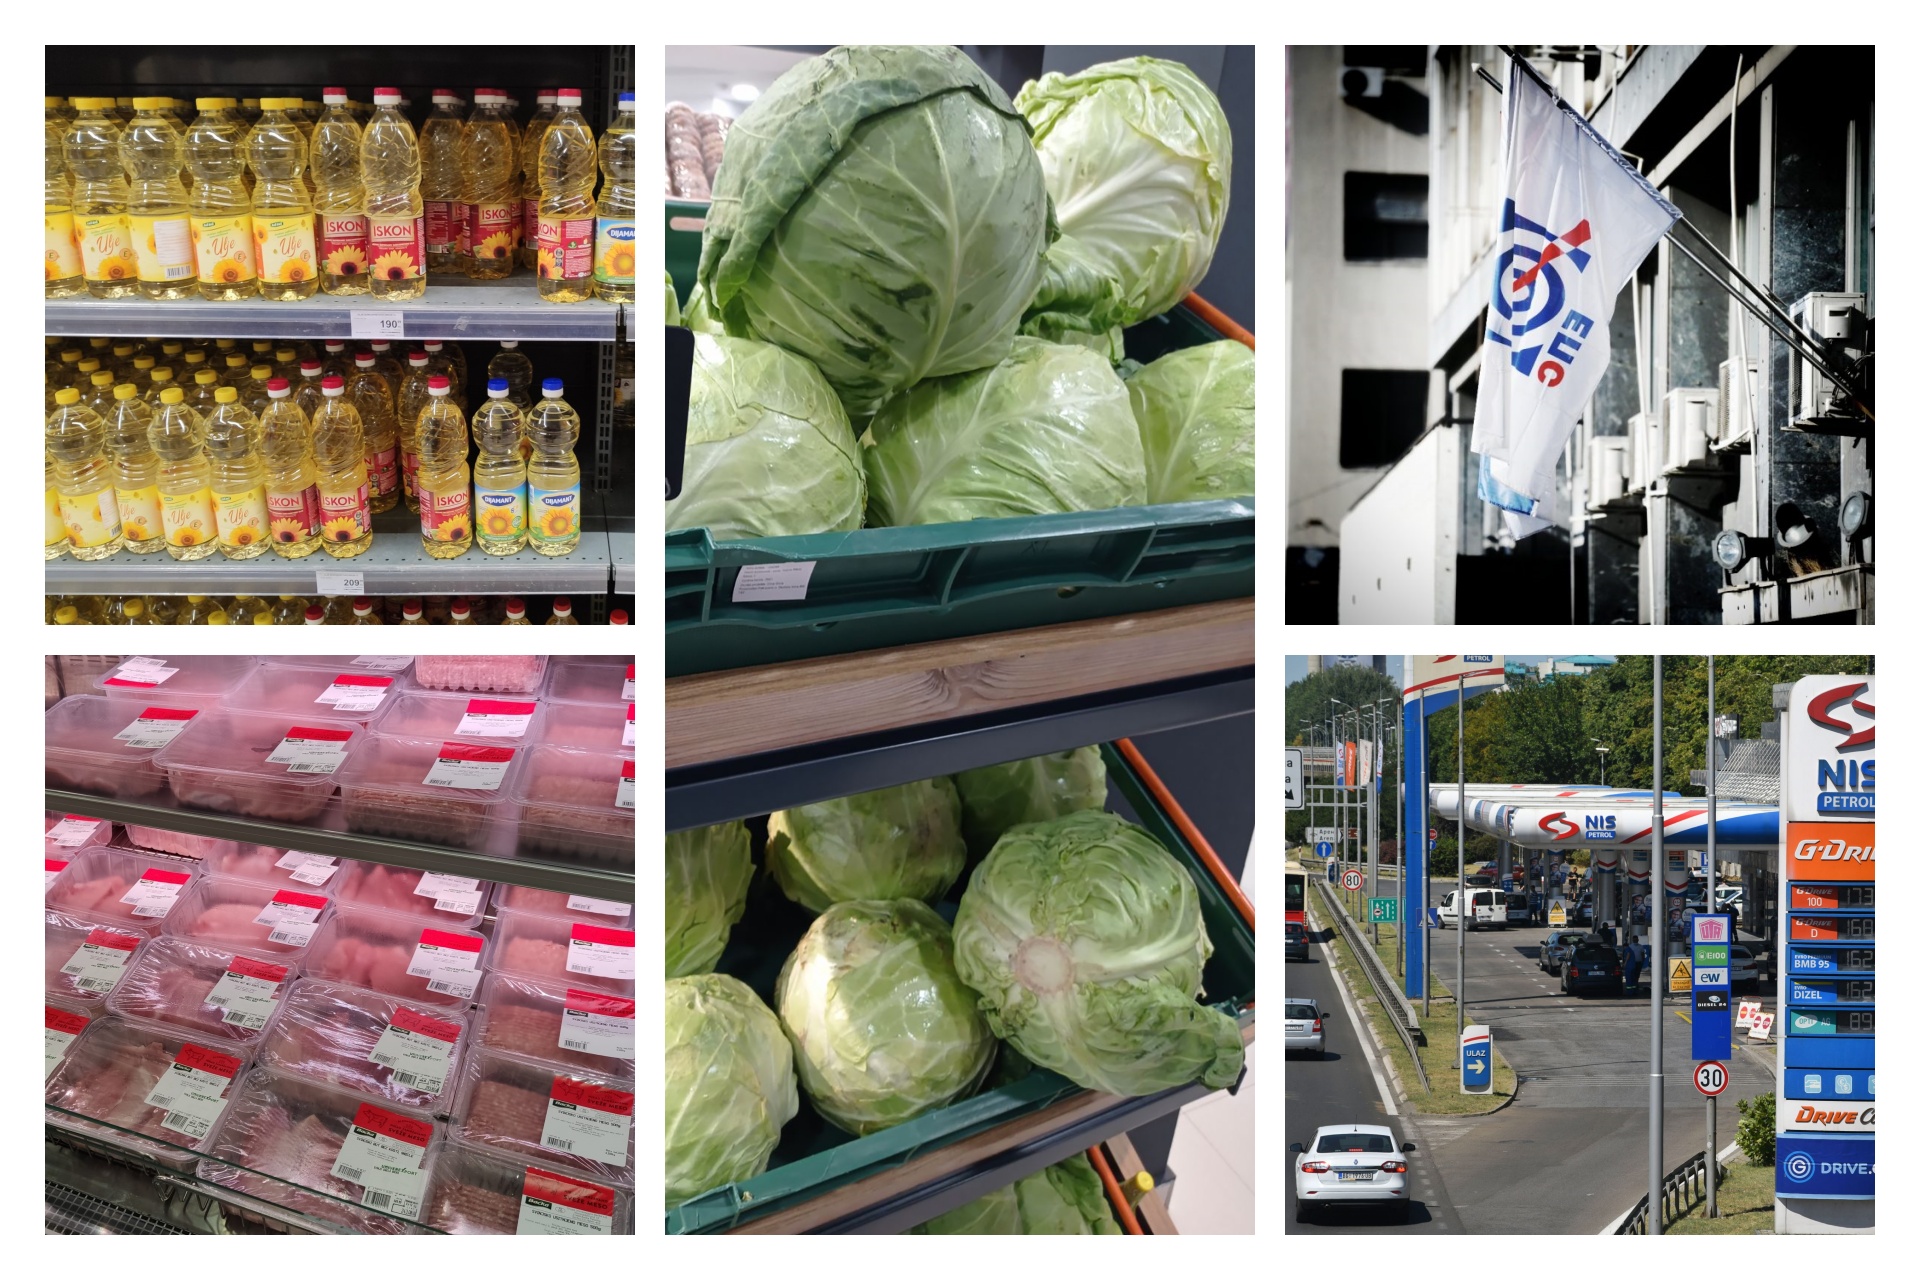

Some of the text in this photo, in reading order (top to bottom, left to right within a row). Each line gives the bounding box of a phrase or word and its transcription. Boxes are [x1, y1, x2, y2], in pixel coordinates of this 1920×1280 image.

[326, 220, 363, 232] ISKON
[373, 225, 411, 237] ISKON
[538, 222, 558, 236] KON
[610, 229, 635, 238] DIJAMA
[96, 234, 121, 255] Ulje
[212, 236, 235, 257] Ulje
[280, 236, 302, 257] Ulje
[380, 320, 398, 328] 190
[322, 495, 356, 506] ISKON
[437, 491, 468, 506] ISKON
[485, 496, 512, 504] DIJAMANT
[545, 495, 573, 505] DIJAMANT
[171, 509, 191, 526] Ulje
[229, 507, 249, 525] Ulje
[1823, 796, 1875, 808] PETROL
[1586, 815, 1616, 830] NIS
[1346, 875, 1359, 886] 80
[1807, 897, 1822, 907] 100
[1811, 929, 1818, 938] D
[1794, 960, 1830, 968] BMB 95
[1794, 991, 1822, 999] DIZEL
[1700, 1068, 1722, 1088] 30
[1795, 1105, 1859, 1126] DRIVE
[1792, 1160, 1806, 1174] G
[586, 1201, 608, 1210] MESO
